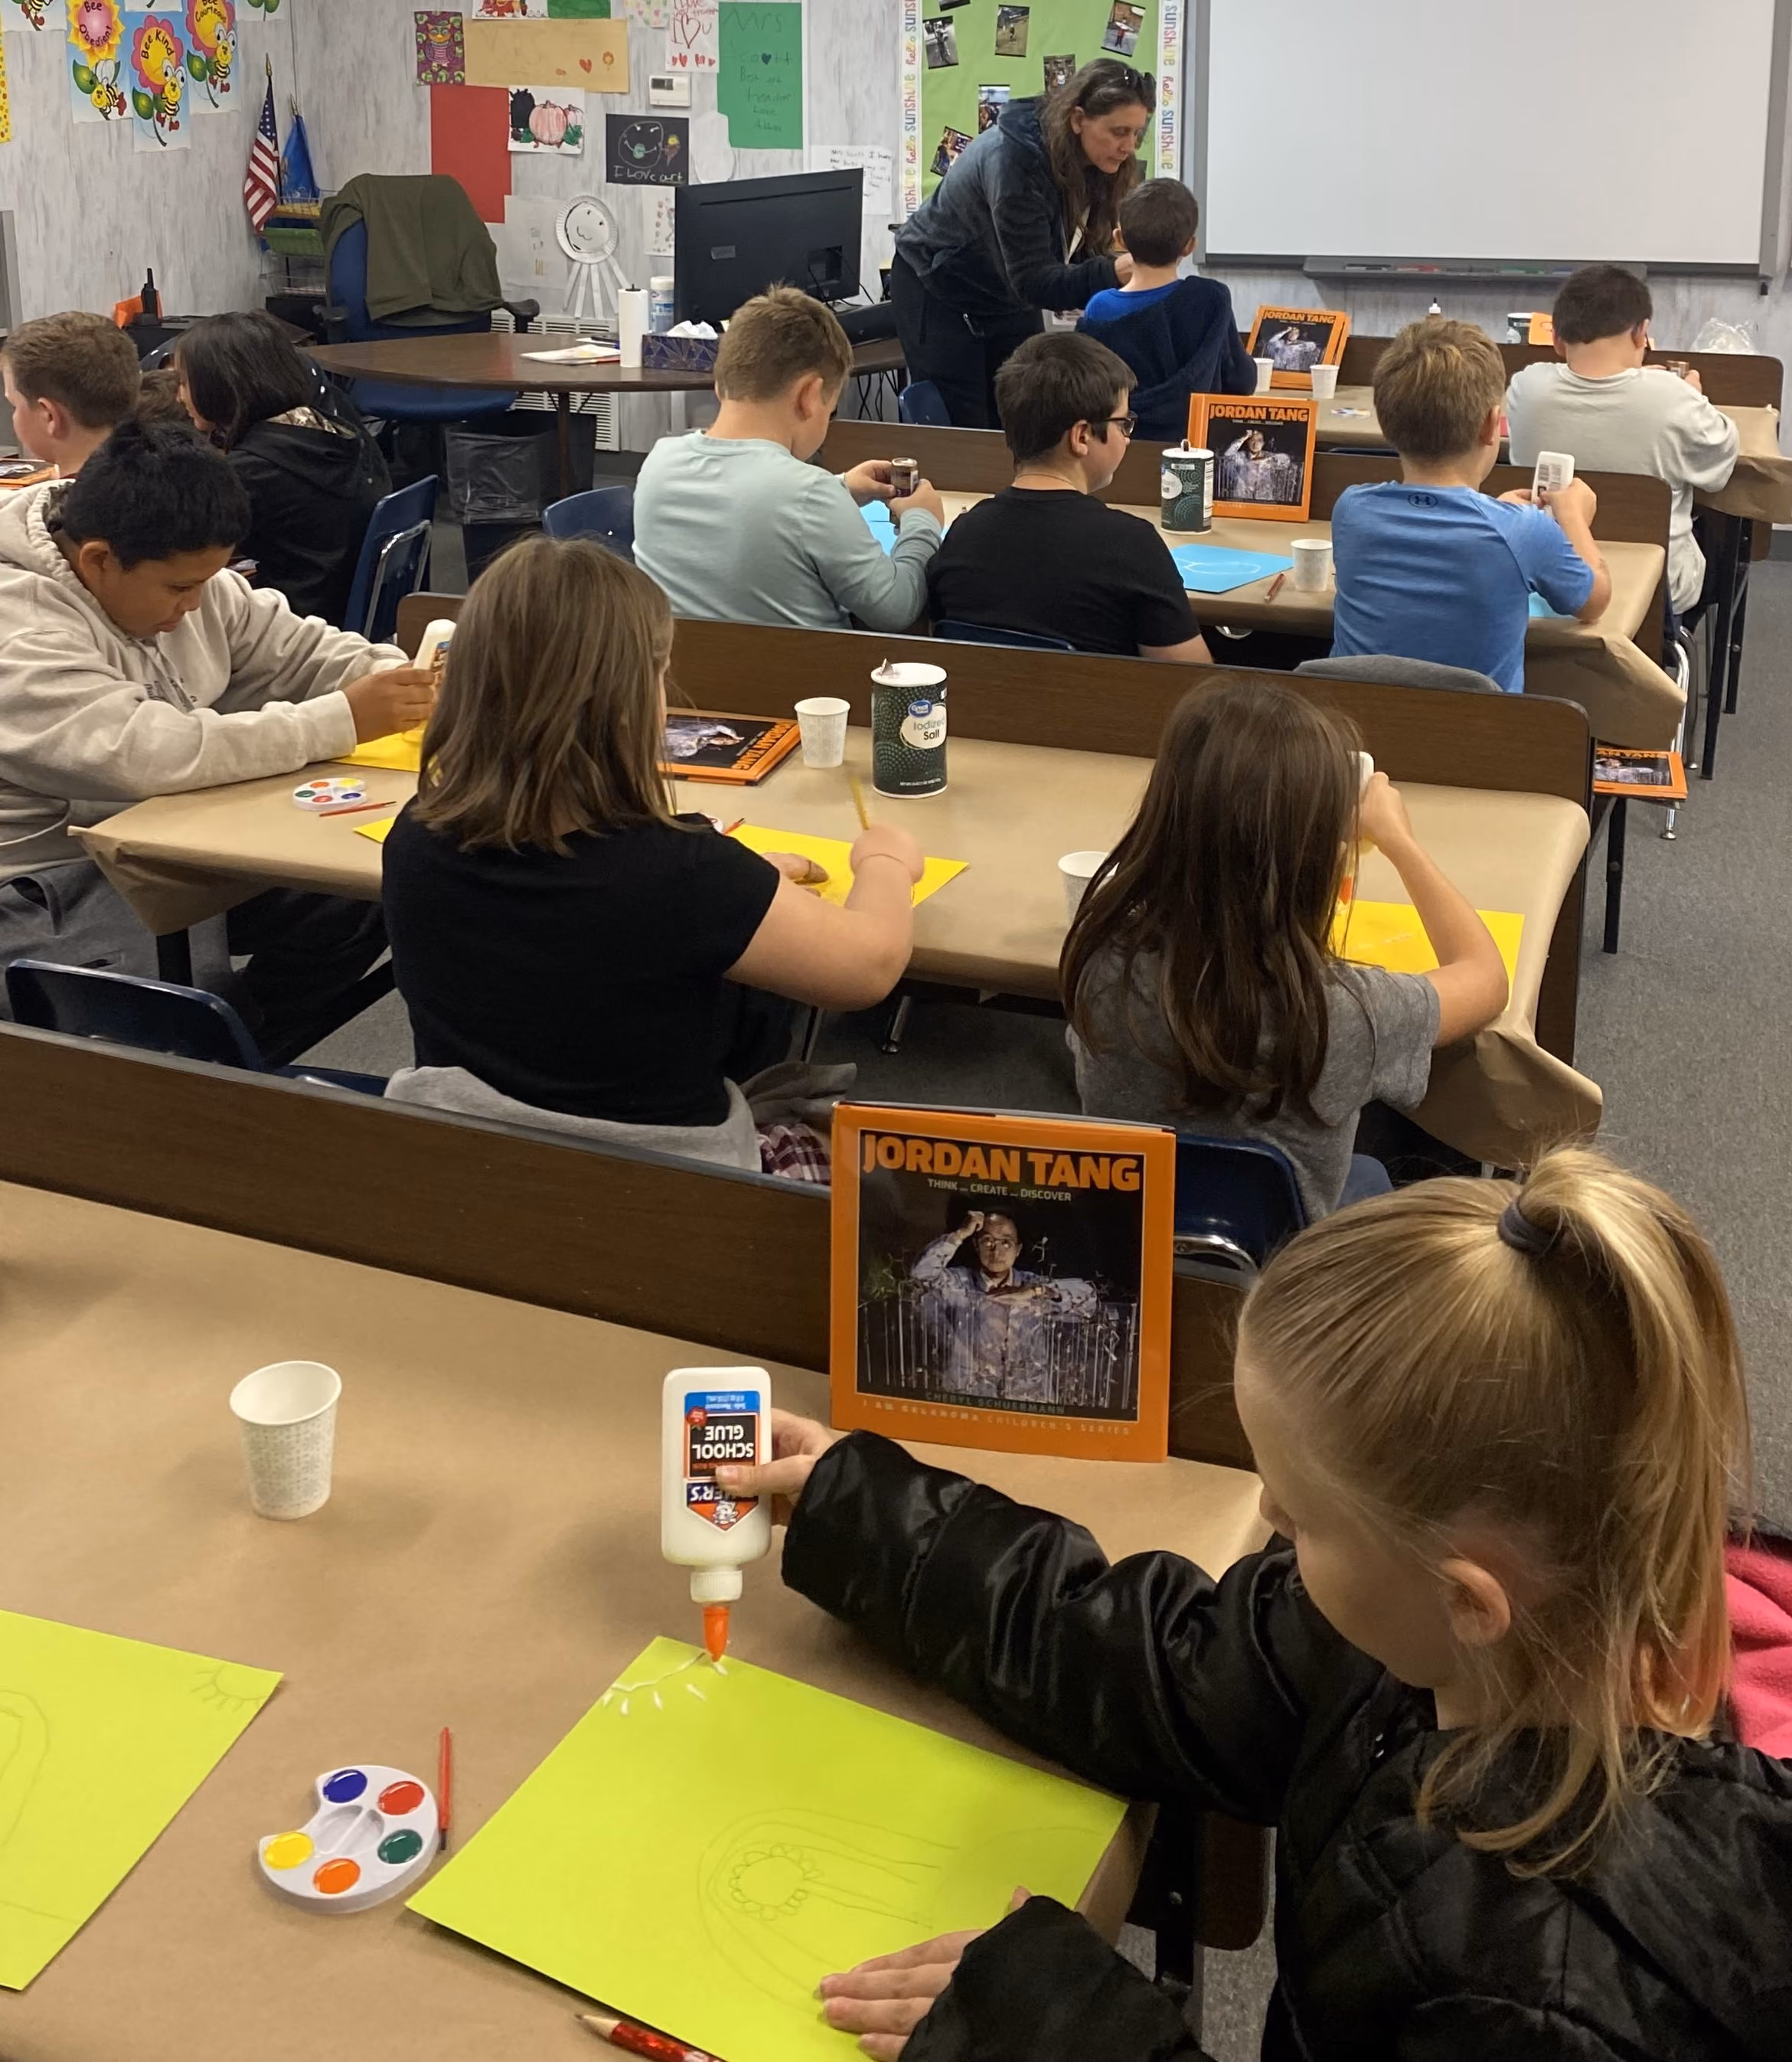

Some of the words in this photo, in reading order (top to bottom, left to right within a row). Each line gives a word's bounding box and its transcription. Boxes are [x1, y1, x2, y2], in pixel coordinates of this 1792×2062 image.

[141, 34, 153, 60] Bee
[155, 28, 175, 57] Kind
[1164, 6, 1178, 66] sunshine
[905, 37, 917, 65] hello
[905, 73, 916, 131] sunshine
[1162, 76, 1174, 106] hello
[906, 135, 917, 163] hello
[1160, 109, 1174, 170] sunshine
[612, 165, 624, 178] I
[660, 172, 683, 182] art
[1264, 311, 1304, 321] JORDAN
[1307, 315, 1335, 323] TANG
[1209, 404, 1267, 420] JORDAN
[1268, 407, 1308, 422] TANG
[913, 715, 945, 731] Iodized
[923, 729, 940, 741] Salt
[863, 1134, 1020, 1183] JORDAN
[1027, 1152, 1141, 1191] TANG
[927, 1178, 958, 1191] THINK
[970, 1183, 1008, 1197] CREATE
[1020, 1188, 1072, 1202] DISCOVER
[704, 1425, 744, 1441] GLUE
[692, 1443, 754, 1459] SCHOOL
